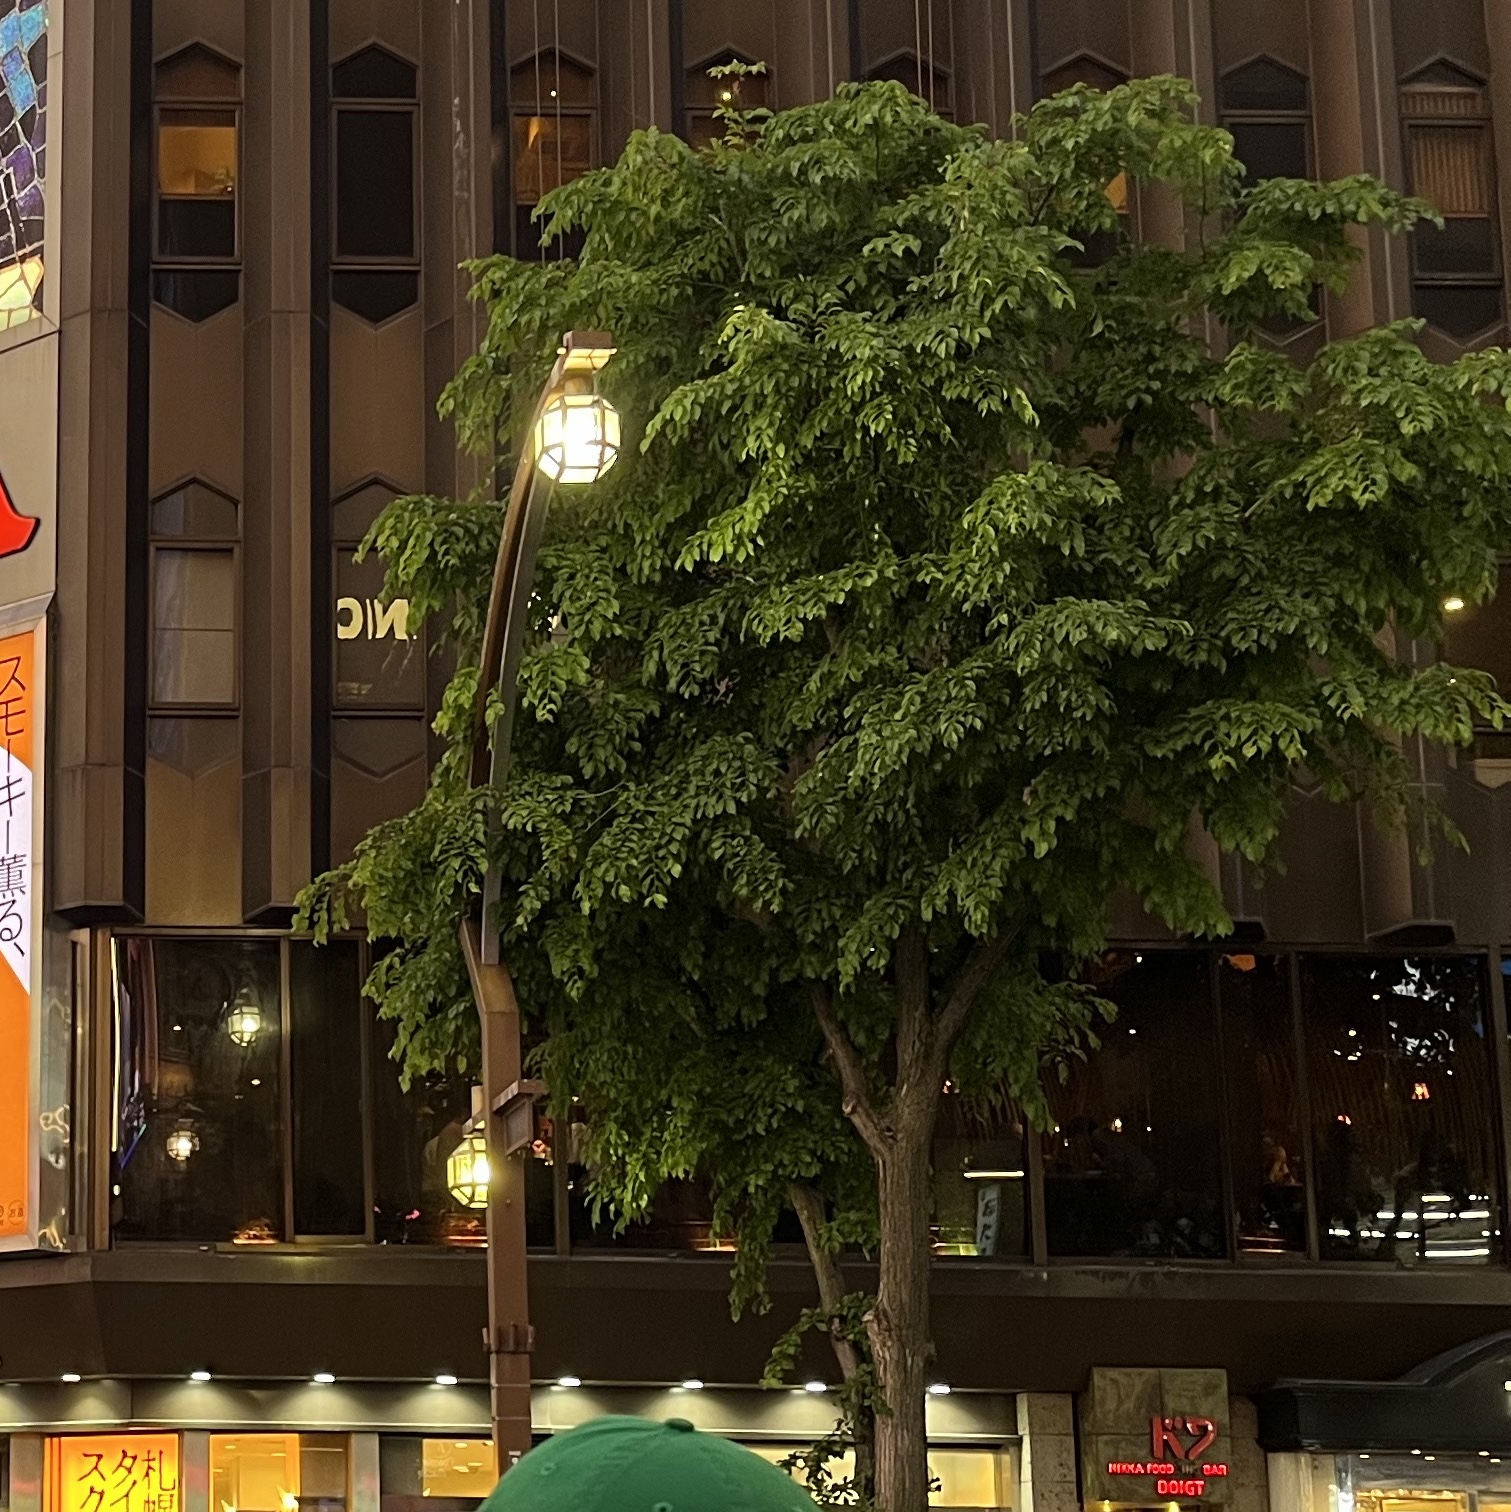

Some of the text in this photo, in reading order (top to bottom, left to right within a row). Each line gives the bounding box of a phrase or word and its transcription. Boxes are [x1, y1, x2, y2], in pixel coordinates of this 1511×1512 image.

[1108, 1462, 1145, 1474] NIKKA
[1147, 1462, 1175, 1474] FOOD
[1202, 1464, 1227, 1476] BAR
[1157, 1479, 1205, 1496] DOIGT
